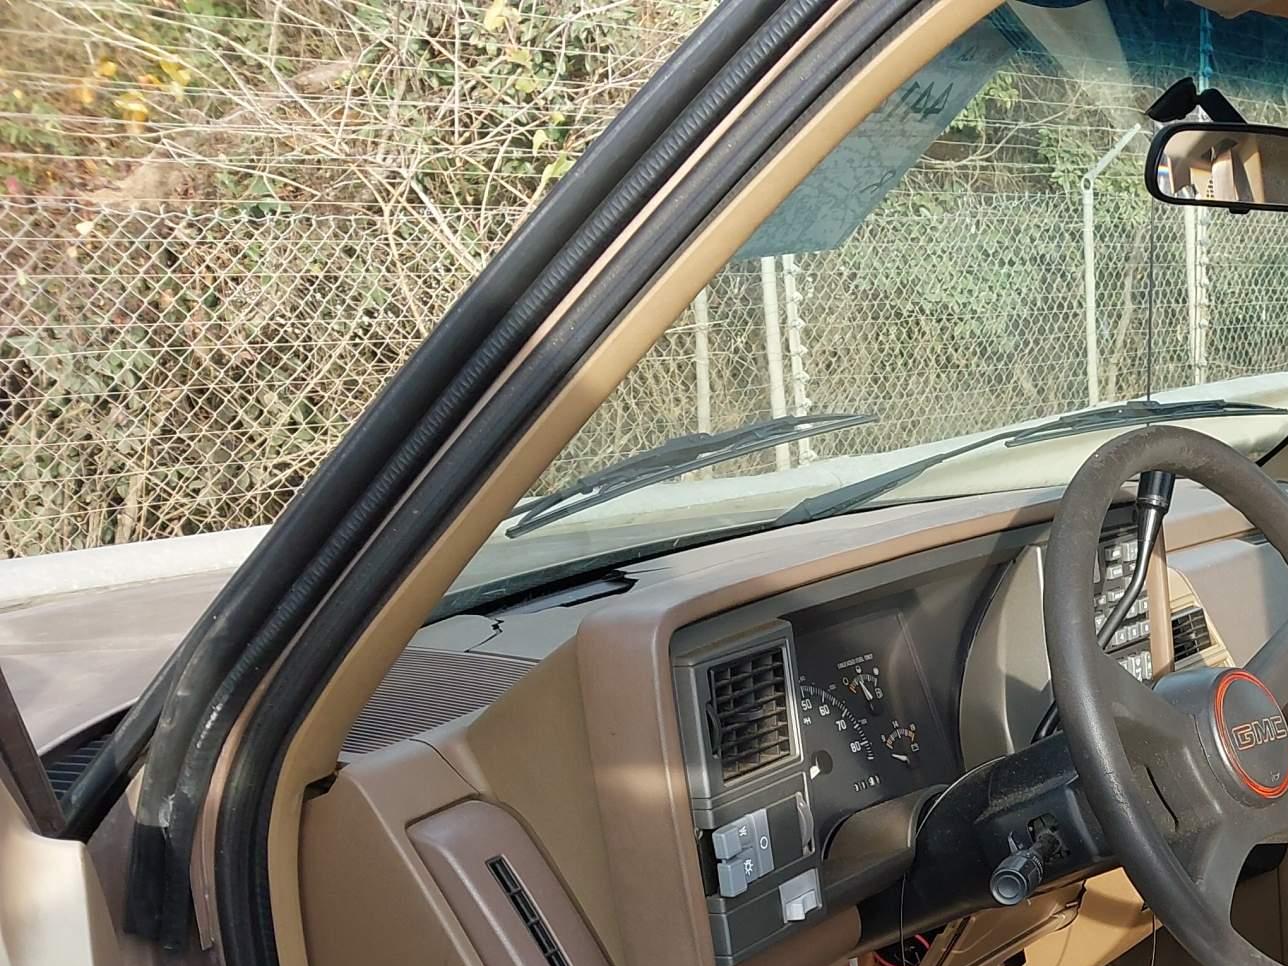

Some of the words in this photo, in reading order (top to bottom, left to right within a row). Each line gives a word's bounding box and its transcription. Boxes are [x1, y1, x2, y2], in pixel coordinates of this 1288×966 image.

[801, 699, 813, 711] 50
[819, 704, 830, 717] 60
[835, 719, 847, 732] 70
[1231, 715, 1288, 751] GMC
[850, 741, 862, 753] 80
